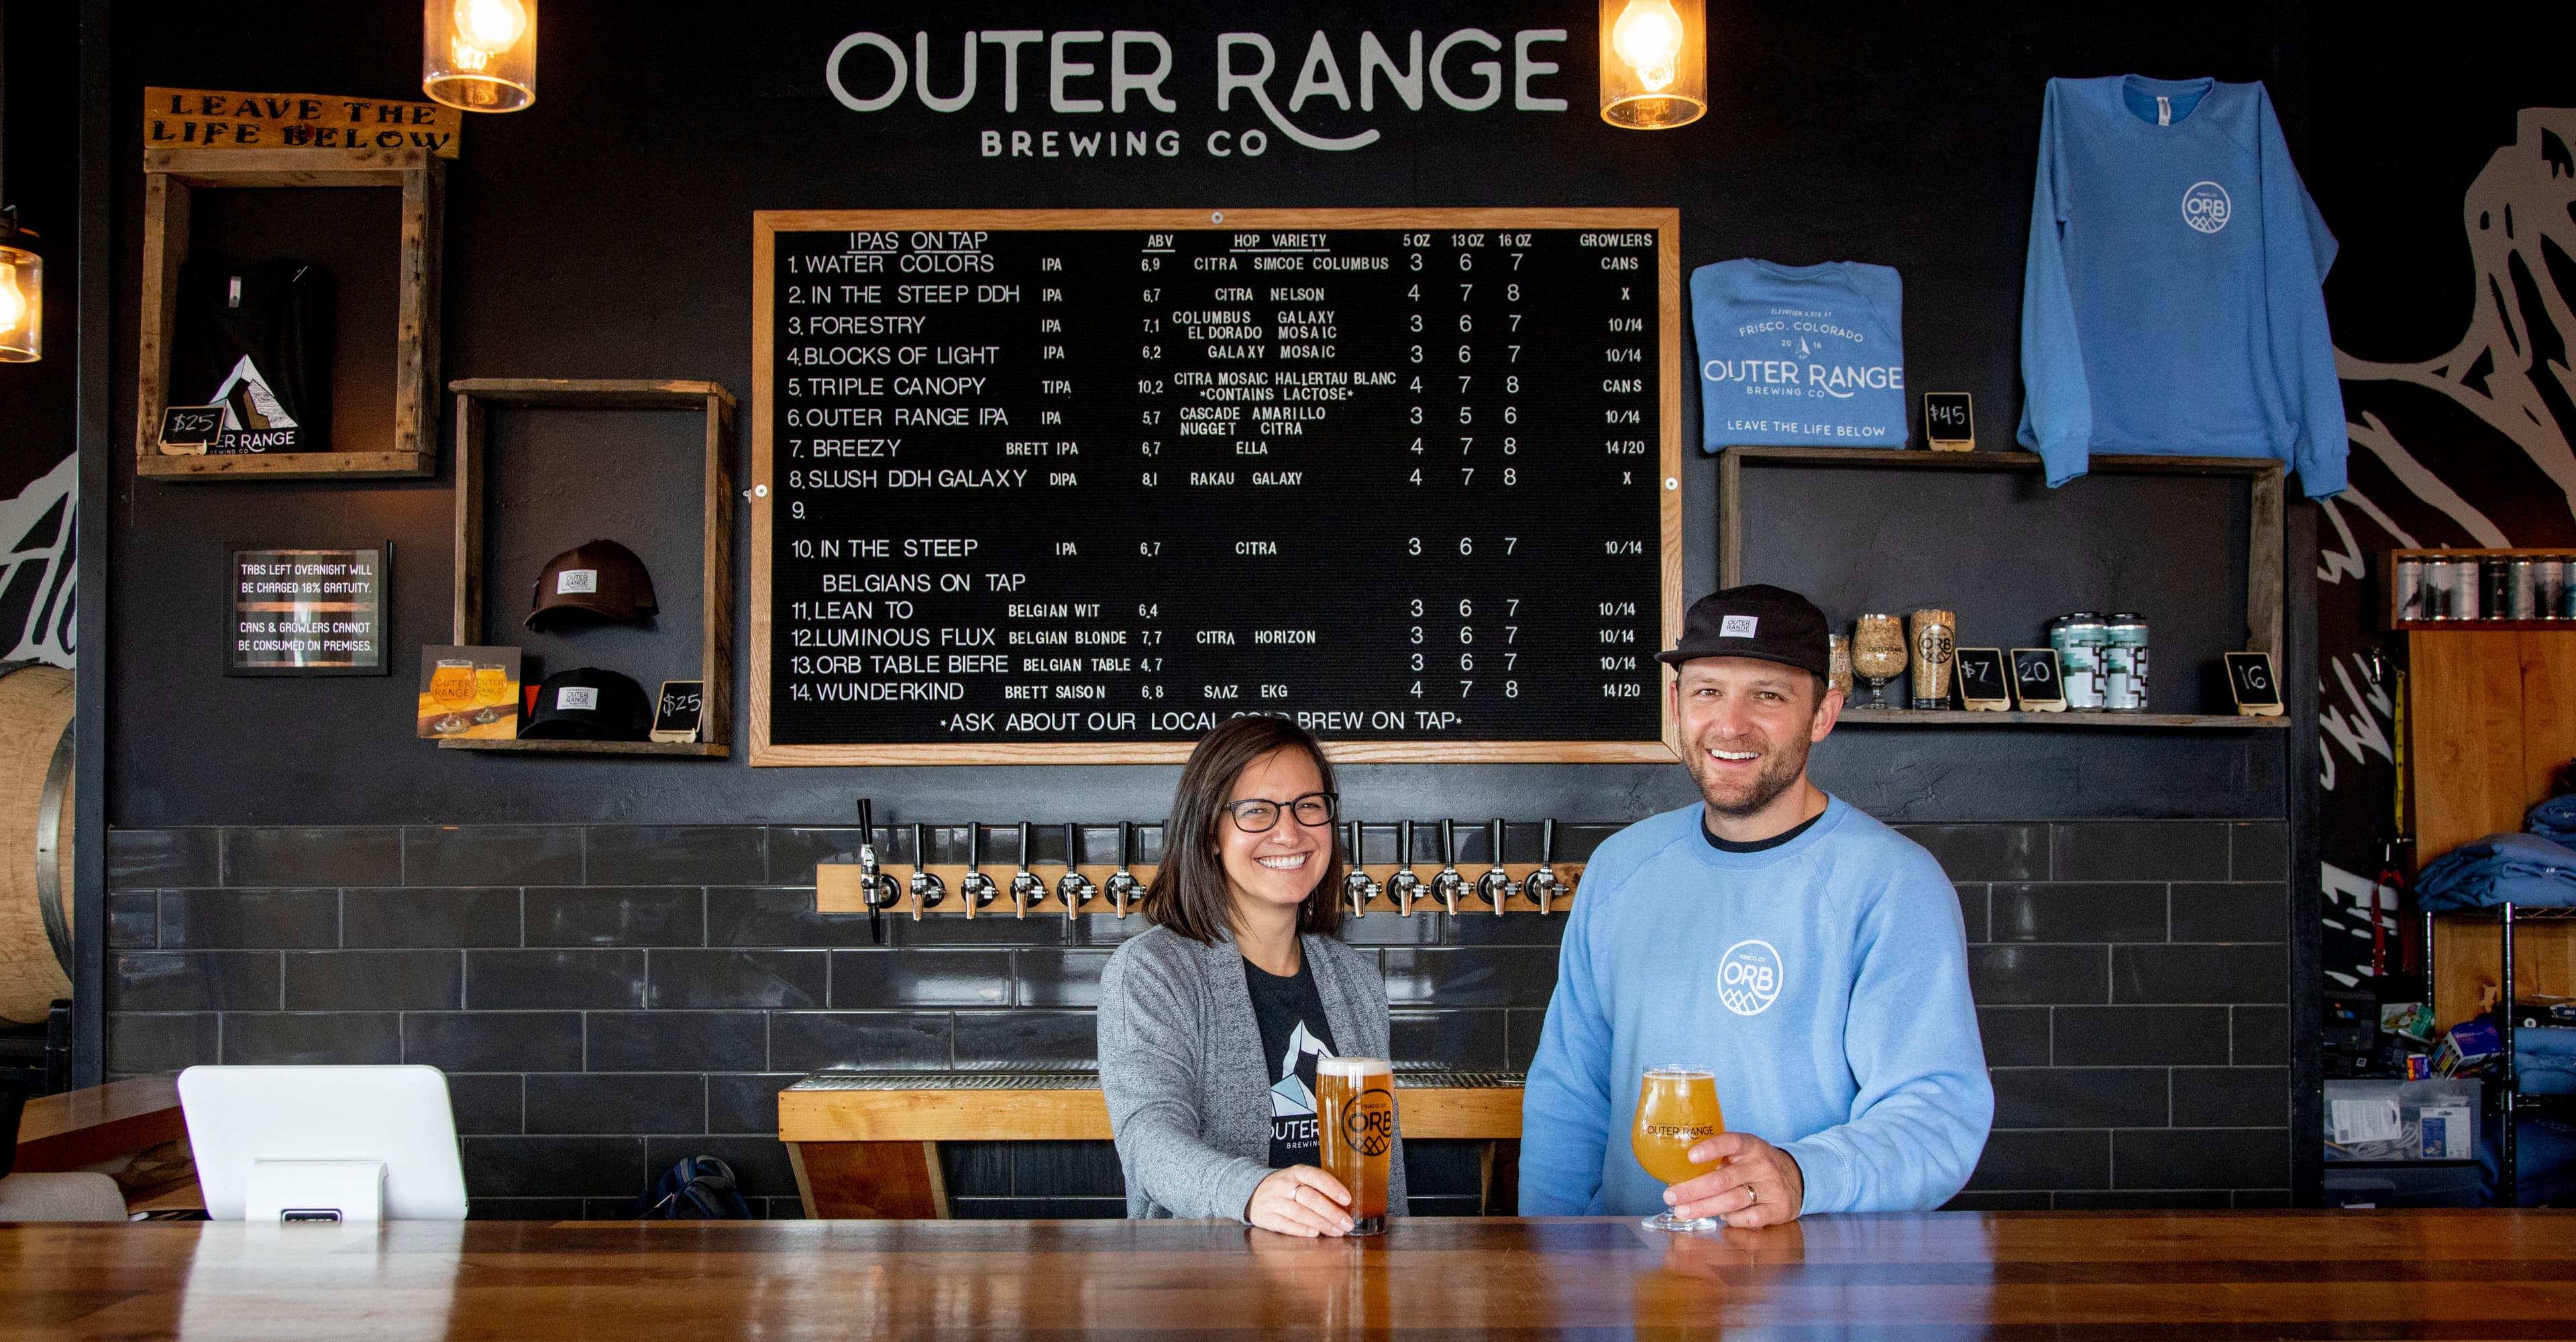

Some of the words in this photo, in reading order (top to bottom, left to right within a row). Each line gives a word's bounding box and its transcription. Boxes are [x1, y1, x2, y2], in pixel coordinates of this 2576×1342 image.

[826, 30, 1176, 113] OUTER
[1218, 28, 1568, 150] RANGE
[171, 95, 323, 120] LEAVE
[344, 102, 437, 125] THE
[152, 120, 261, 145] LIFE
[283, 125, 450, 152] BELOW
[981, 130, 1181, 157] BREWING
[1208, 130, 1267, 157] CO
[2188, 197, 2226, 217] ORB
[851, 231, 899, 250] IPAS
[911, 231, 943, 250] ON
[948, 231, 988, 250] TAP
[1147, 234, 1173, 248] ABV
[1234, 234, 1260, 248] HOP
[1271, 234, 1327, 248] VARIETY
[1403, 234, 1411, 247] 5
[1413, 234, 1431, 247] OZ
[1452, 234, 1466, 247] 13
[1467, 234, 1485, 247] OZ
[1499, 233, 1512, 247] 16
[1515, 234, 1532, 247] OZ
[1580, 233, 1653, 248] GROWLERS
[805, 255, 883, 273] WATER
[900, 254, 994, 273] COLORS
[1042, 258, 1062, 271] IPA
[1194, 257, 1238, 270] CITRA
[1254, 256, 1304, 270] SIMCOE
[1312, 257, 1389, 270] COLUMBUS
[1601, 256, 1639, 270] CANS
[812, 286, 831, 304] IN
[841, 285, 881, 303] THE
[898, 285, 969, 303] STEEP
[978, 285, 1020, 303] DDH
[1215, 287, 1254, 301] CITRA
[1271, 287, 1324, 301] NELSON
[1172, 311, 1251, 325] COLUMBUS
[1277, 311, 1335, 324] GALAXY
[1770, 309, 1803, 317] ELEVATION
[810, 316, 926, 335] FORESTRY
[1188, 325, 1205, 340] EL
[1208, 325, 1263, 340] DORADO
[1278, 325, 1337, 340] MOSAIC
[1793, 321, 1864, 343] COLORADO
[898, 346, 928, 365] OF
[937, 346, 1000, 364] LIGHT
[808, 377, 884, 396] TRIPLE
[894, 376, 986, 396] CANOPY
[1174, 372, 1213, 386] CITRA
[1218, 372, 1269, 386] MOSAIC
[1275, 371, 1348, 386] HALLERTAU
[1354, 371, 1397, 385] BLANC
[1704, 360, 1799, 384] OUTER
[1809, 366, 1904, 398] RANGE
[1042, 380, 1071, 394] TIPA
[1746, 386, 1802, 397] BREWING
[1808, 389, 1825, 399] CO
[895, 407, 969, 426] RANGE
[979, 407, 1009, 425] IPA
[1179, 407, 1240, 420] CASCADE
[1252, 407, 1326, 421] AMARILLO
[1929, 404, 1966, 425] $45
[171, 413, 216, 433] $25
[1727, 420, 1768, 431] LEAVE
[1773, 421, 1799, 433] THE
[1804, 424, 1832, 435] LIFE
[1837, 425, 1886, 437] BELOW
[241, 431, 295, 452] RANGE
[813, 439, 902, 458] BREEZY
[1006, 442, 1049, 456] BRETT
[1057, 442, 1079, 456] IPA
[1236, 441, 1268, 455] ELLA
[888, 469, 931, 488] DDH
[938, 469, 1028, 488] GALAXY
[1050, 472, 1077, 486] DIPA
[1190, 472, 1234, 486] RAKAU
[1252, 472, 1303, 485] GALAXY
[241, 564, 266, 576] TABS
[269, 564, 292, 576] LEFT
[294, 564, 346, 576] OVERNIGHT
[350, 564, 373, 576] WILL
[241, 582, 254, 593] BE
[257, 582, 299, 593] CHARGED
[301, 582, 321, 593] 18%
[324, 582, 372, 593] GRATUITY.
[566, 580, 588, 588] RANGE
[822, 574, 931, 592] BELGIANS
[940, 573, 970, 592] ON
[985, 573, 1026, 592] TAP
[815, 601, 873, 620] LEAN
[884, 601, 914, 619] TO
[1008, 603, 1068, 618] BELGIAN
[1074, 603, 1101, 617] WIT
[240, 622, 265, 633] CANS
[268, 622, 277, 633] &
[280, 622, 330, 633] GROWLERS
[333, 622, 371, 633] CANNOT
[941, 627, 996, 646] FLUX
[1009, 630, 1067, 645] BELGIAN
[1075, 630, 1127, 645] BLONDE
[238, 640, 250, 652] BE
[253, 640, 305, 652] CONSUMED
[307, 640, 321, 652] ON
[323, 640, 373, 652] PREMISES.
[869, 655, 941, 674] TABLE
[949, 654, 1009, 673] BIERE
[1023, 658, 1082, 672] BELGIAN
[1091, 658, 1131, 672] TABLE
[1961, 660, 1990, 683] $7
[2019, 661, 2051, 682] 20
[435, 678, 472, 688] OUTER
[2238, 665, 2267, 689] 16
[435, 688, 470, 701] RANGE
[816, 682, 964, 701] WUNDERKIND
[1005, 685, 1049, 699] BRETT
[1055, 684, 1106, 699] SAISON
[566, 696, 588, 705] RANGE
[663, 693, 702, 717] $25
[1005, 713, 1081, 731] ABOUT
[1087, 712, 1136, 731] OUR
[1297, 711, 1364, 730] BREW
[1371, 711, 1405, 730] ON
[1724, 962, 1774, 993] ORB
[1348, 1110, 1391, 1135] ORB
[1647, 1125, 1680, 1137] OUTER
[1682, 1125, 1715, 1139] RANGE
[1286, 1141, 1320, 1149] BREWIN
